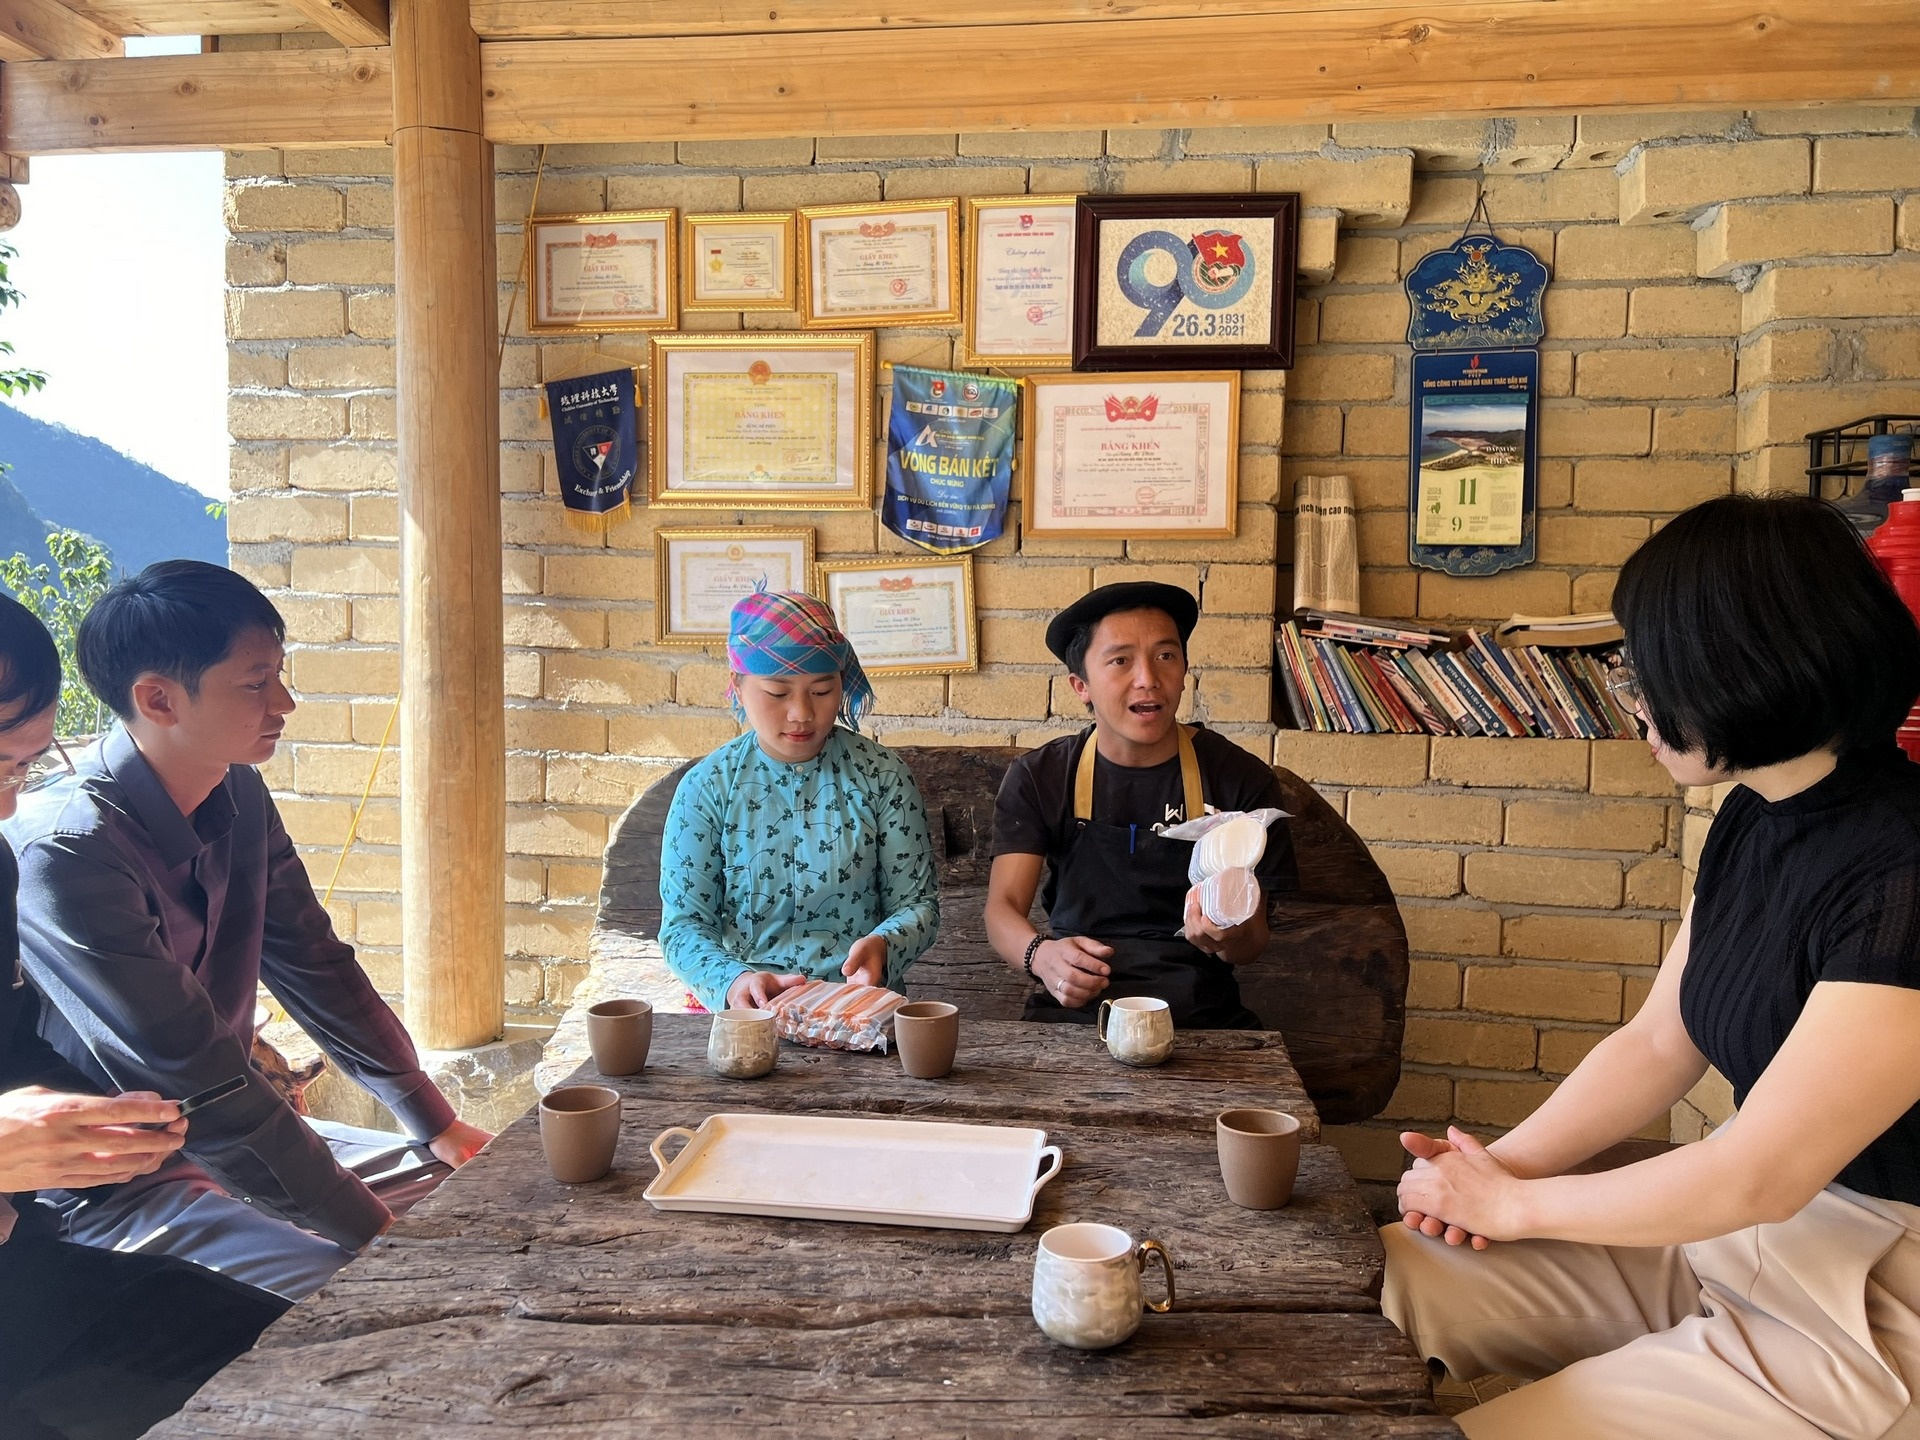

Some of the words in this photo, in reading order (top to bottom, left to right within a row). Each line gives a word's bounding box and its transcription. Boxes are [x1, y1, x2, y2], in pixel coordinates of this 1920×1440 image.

[600, 263, 618, 272] KHEN
[1219, 314, 1245, 324] 1931
[1172, 314, 1216, 337] 26.3
[1218, 325, 1245, 336] 2021
[1423, 379, 1436, 388] TỔNG
[1437, 379, 1450, 387] CÔNG
[1451, 379, 1457, 387] TY
[1494, 377, 1506, 385] THÁC
[1519, 375, 1528, 383] KHÍ
[598, 396, 620, 404] Technology
[761, 411, 786, 419] KHEN
[1101, 440, 1128, 451] BẰNG
[1132, 442, 1160, 450] KHEN
[900, 448, 937, 475] VÒNG
[938, 454, 969, 478] BÁN
[972, 451, 999, 478] KẾT
[598, 487, 604, 495] &
[604, 469, 632, 493] Friendship
[930, 477, 946, 487] CHÚC
[946, 478, 965, 488] MỪNG
[1459, 477, 1477, 505] 11
[925, 499, 938, 507] LỊCH
[1301, 504, 1314, 514] lịch
[1328, 506, 1342, 515] cao
[1452, 516, 1462, 532] 9
[1446, 664, 1459, 679] LUYỆN
[1457, 677, 1467, 689] DỊCH
